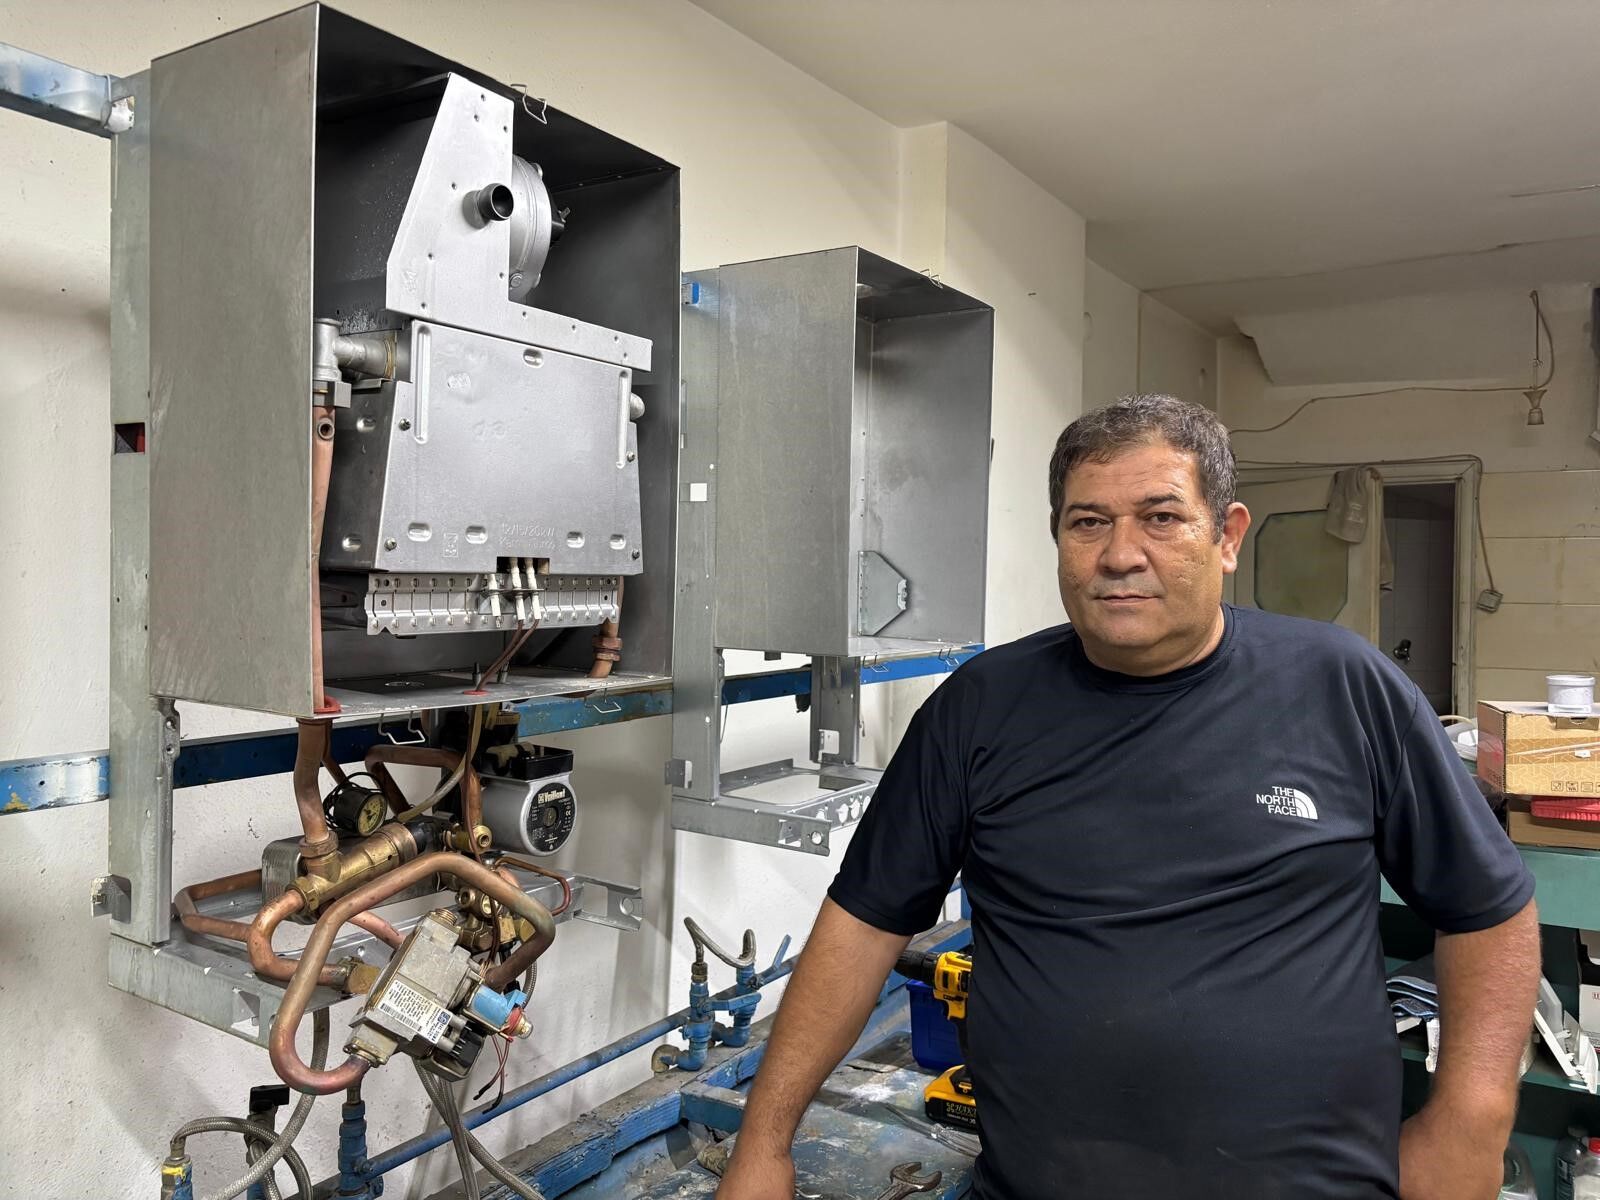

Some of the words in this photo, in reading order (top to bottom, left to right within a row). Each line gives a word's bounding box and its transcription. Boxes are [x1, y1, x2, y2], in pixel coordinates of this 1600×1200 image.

[545, 788, 566, 802] Vaillant
[1272, 786, 1294, 797] THE
[1256, 794, 1295, 806] NORTH
[1268, 804, 1297, 816] FACE
